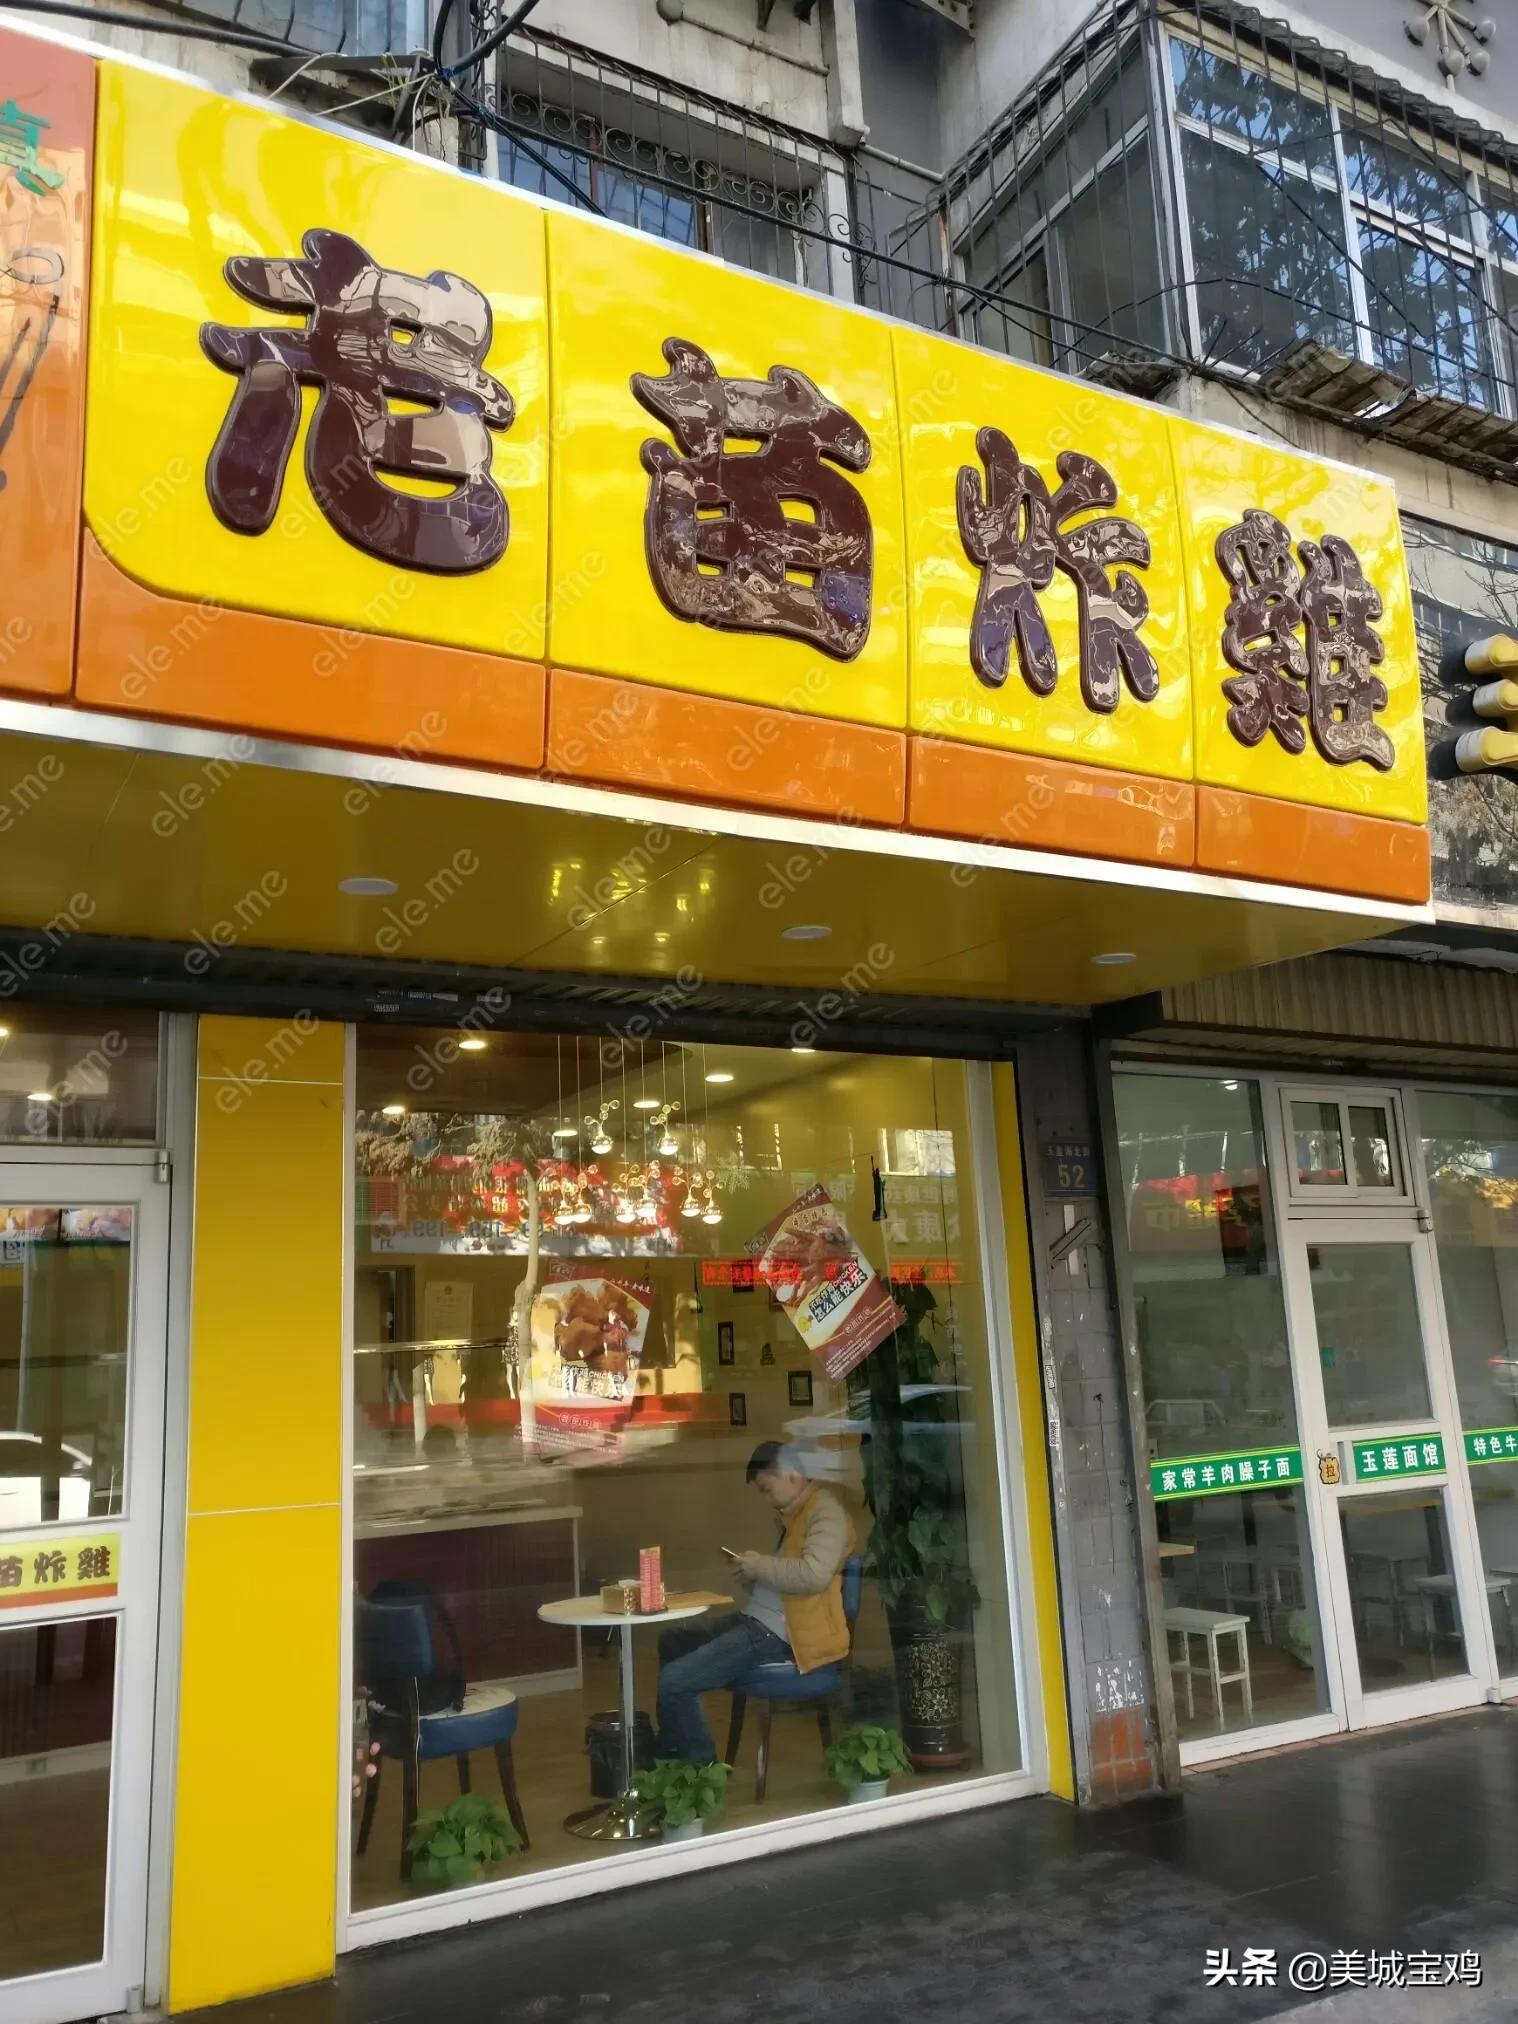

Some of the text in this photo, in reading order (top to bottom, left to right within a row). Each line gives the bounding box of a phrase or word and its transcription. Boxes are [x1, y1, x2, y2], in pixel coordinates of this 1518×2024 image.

[1058, 1164, 1087, 1188] 52
[813, 1269, 868, 1322] 怎么能快乐
[1363, 1443, 1440, 1473] 玉莲面馆
[1473, 1434, 1518, 1456] 特色牛
[1162, 1457, 1291, 1492] 家常羊肉臊子面
[1325, 1464, 1336, 1478] 拉
